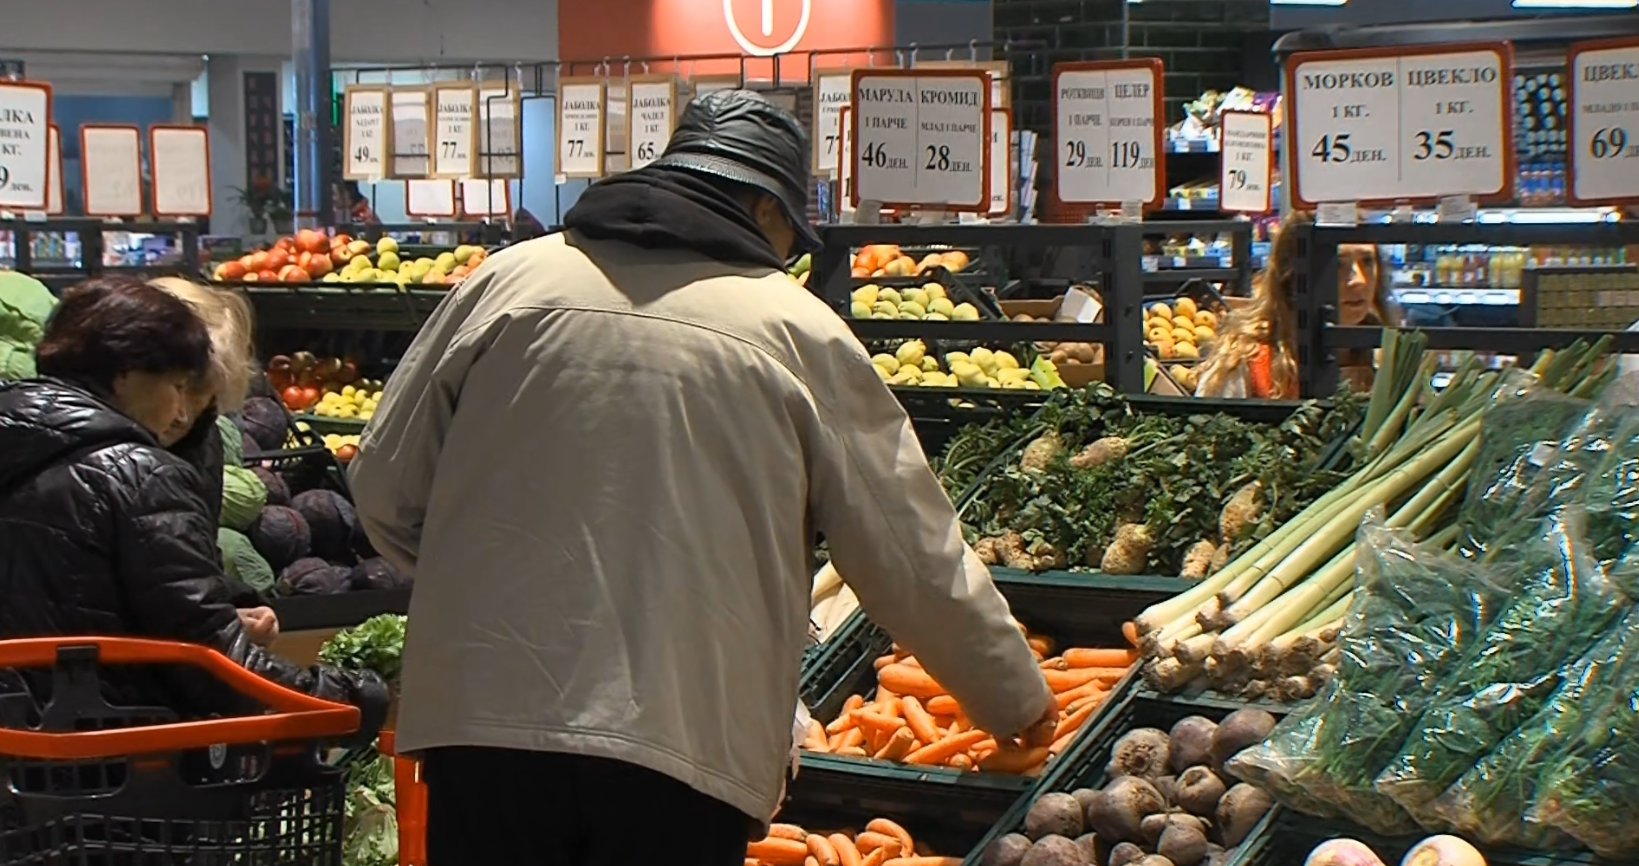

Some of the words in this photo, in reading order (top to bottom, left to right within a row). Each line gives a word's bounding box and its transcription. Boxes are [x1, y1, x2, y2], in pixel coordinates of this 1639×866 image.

[1303, 71, 1393, 89] МОРКОВ
[1408, 67, 1496, 86] ЦВЕКЛО
[1583, 63, 1639, 82] ЦВЕК
[858, 88, 913, 104] МАРУЛА
[921, 90, 978, 106] КРОМИД
[1114, 83, 1150, 98] ЦЕЛЕР
[564, 100, 600, 110] ЈАБОЛКА
[633, 97, 671, 108] ЈАБОЛКА
[1344, 104, 1370, 117] КГ.
[1446, 101, 1475, 115] КГ.
[872, 116, 908, 130] ПАРЧЕ
[442, 141, 457, 159] 77
[567, 140, 584, 158] 77
[637, 141, 655, 160] 65
[1311, 133, 1350, 163] 45
[1350, 149, 1387, 163] ДЕН.
[1414, 130, 1454, 160] 35
[1454, 146, 1491, 160] ДЕН.
[1591, 128, 1626, 159] 69
[354, 145, 369, 163] 49
[861, 142, 887, 168] 46
[925, 145, 950, 171] 28
[1066, 140, 1086, 167] 29
[1112, 141, 1140, 168] 119
[1229, 169, 1246, 190] 79
